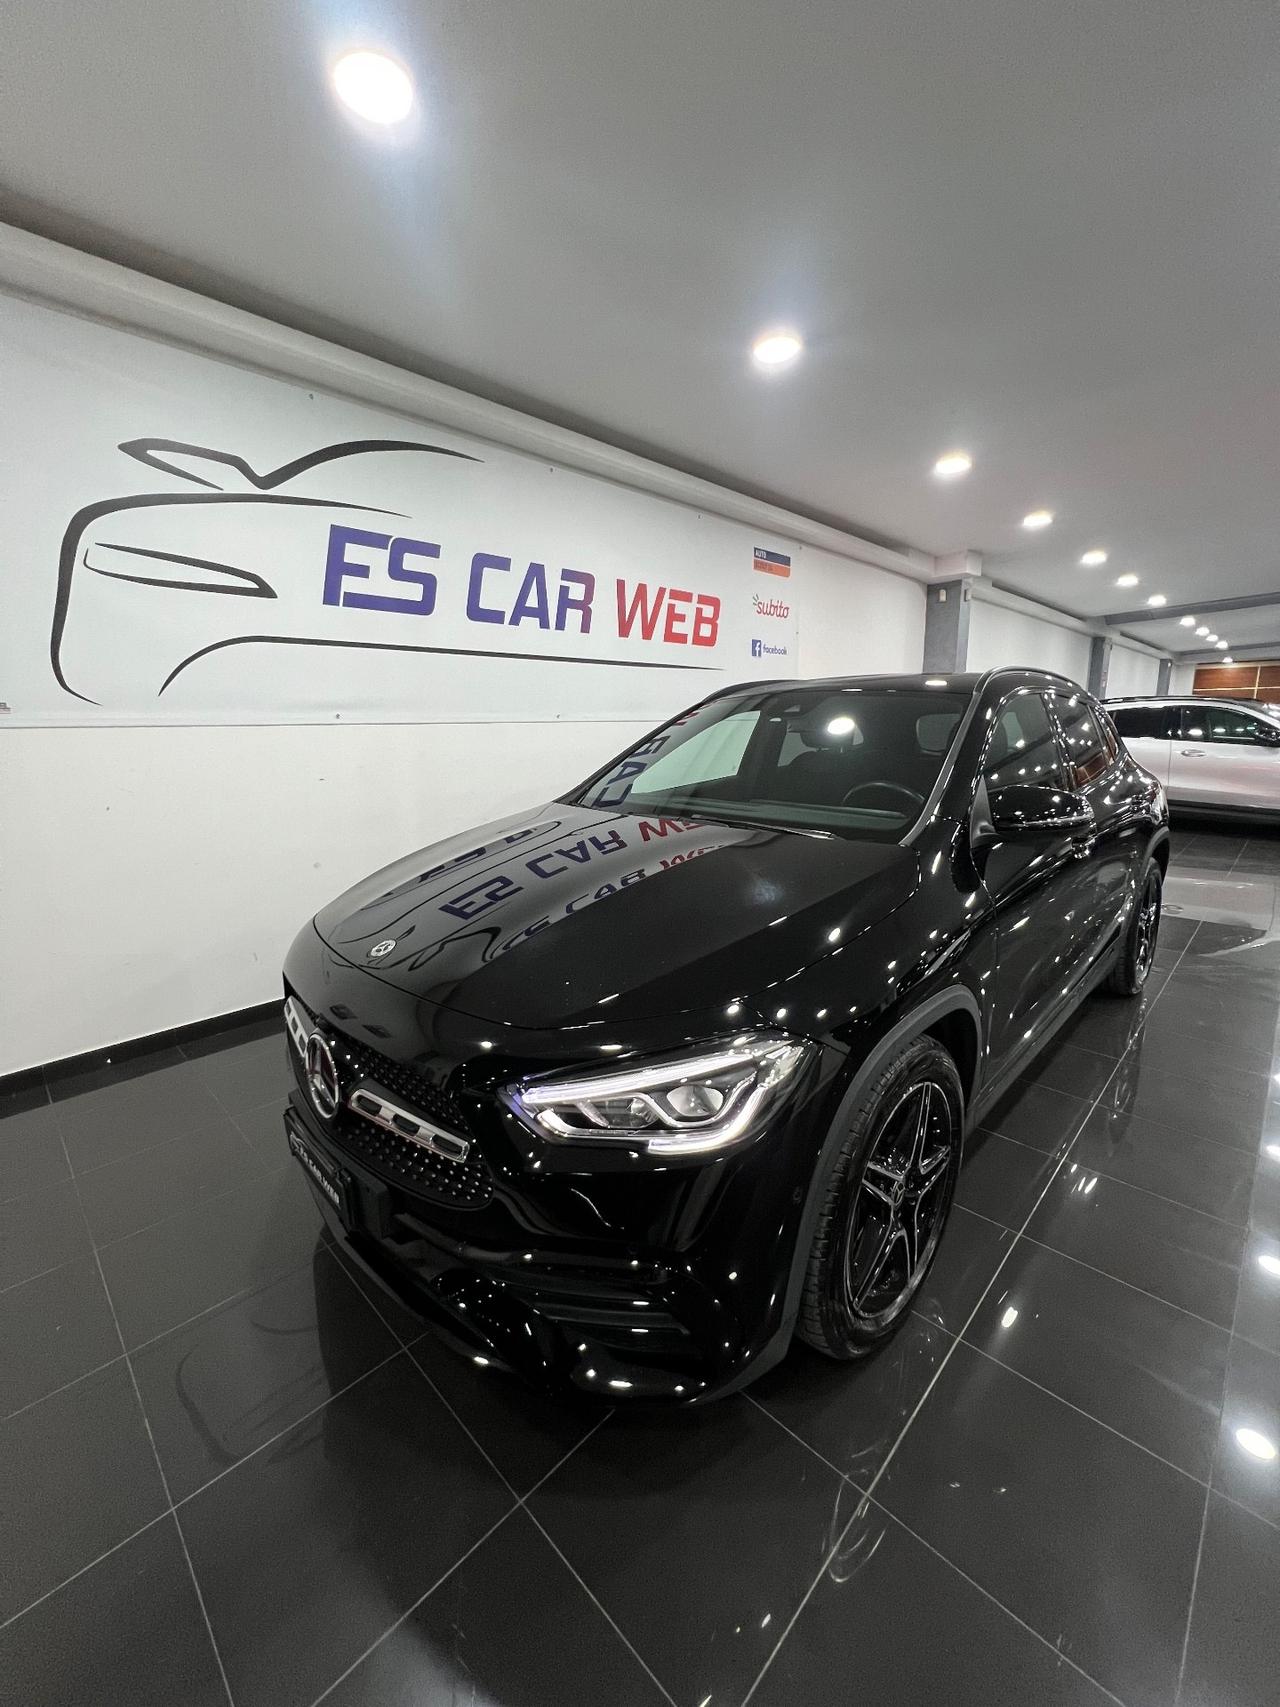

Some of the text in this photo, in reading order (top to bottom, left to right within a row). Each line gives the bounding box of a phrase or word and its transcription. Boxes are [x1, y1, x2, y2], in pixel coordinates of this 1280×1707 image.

[323, 523, 721, 647] ES CAR WEB
[756, 599, 789, 618] subito
[763, 644, 787, 655] facebook
